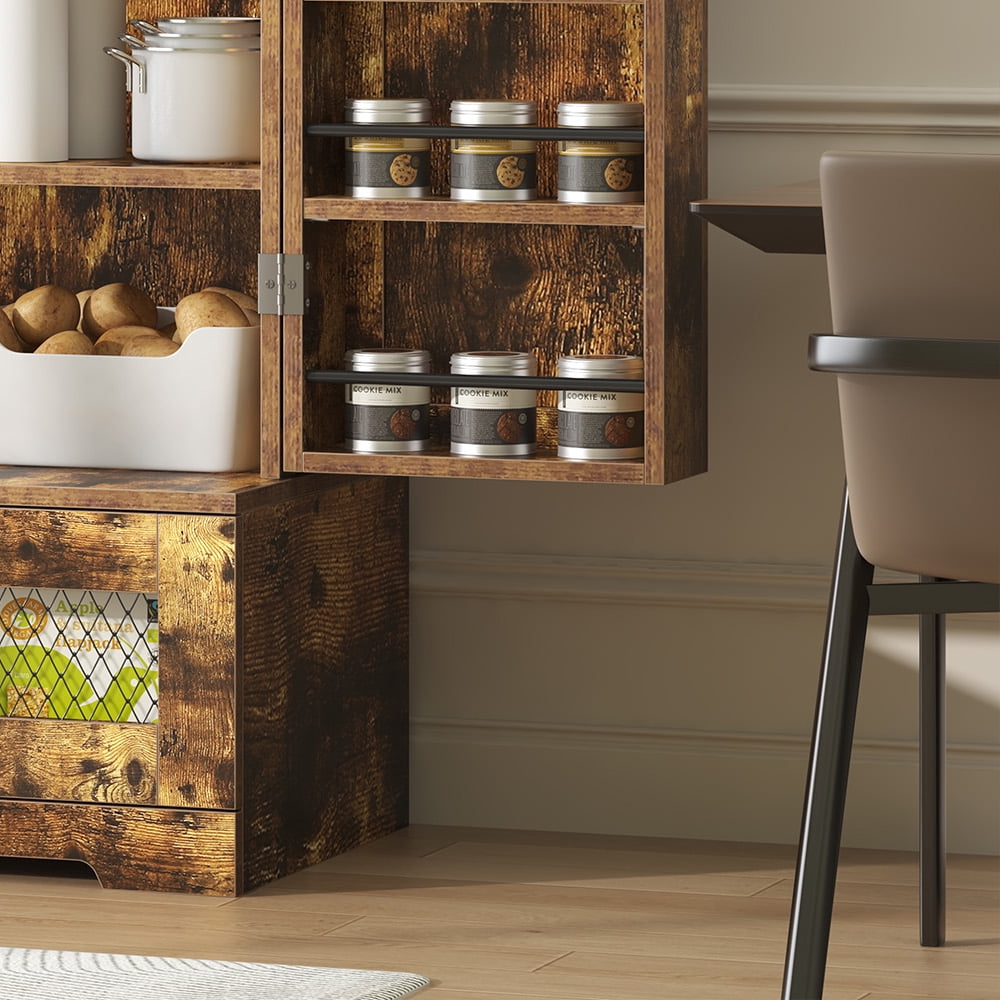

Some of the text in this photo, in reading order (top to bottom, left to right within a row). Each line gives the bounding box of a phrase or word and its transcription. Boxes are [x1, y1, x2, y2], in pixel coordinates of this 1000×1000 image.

[353, 385, 402, 394] COOKIE MIX
[459, 388, 509, 397] COOKIE MIX
[567, 392, 617, 401] COOKIE MIX
[55, 599, 104, 616] Apple
[72, 618, 134, 633] sultana
[55, 635, 122, 652] flapjack
